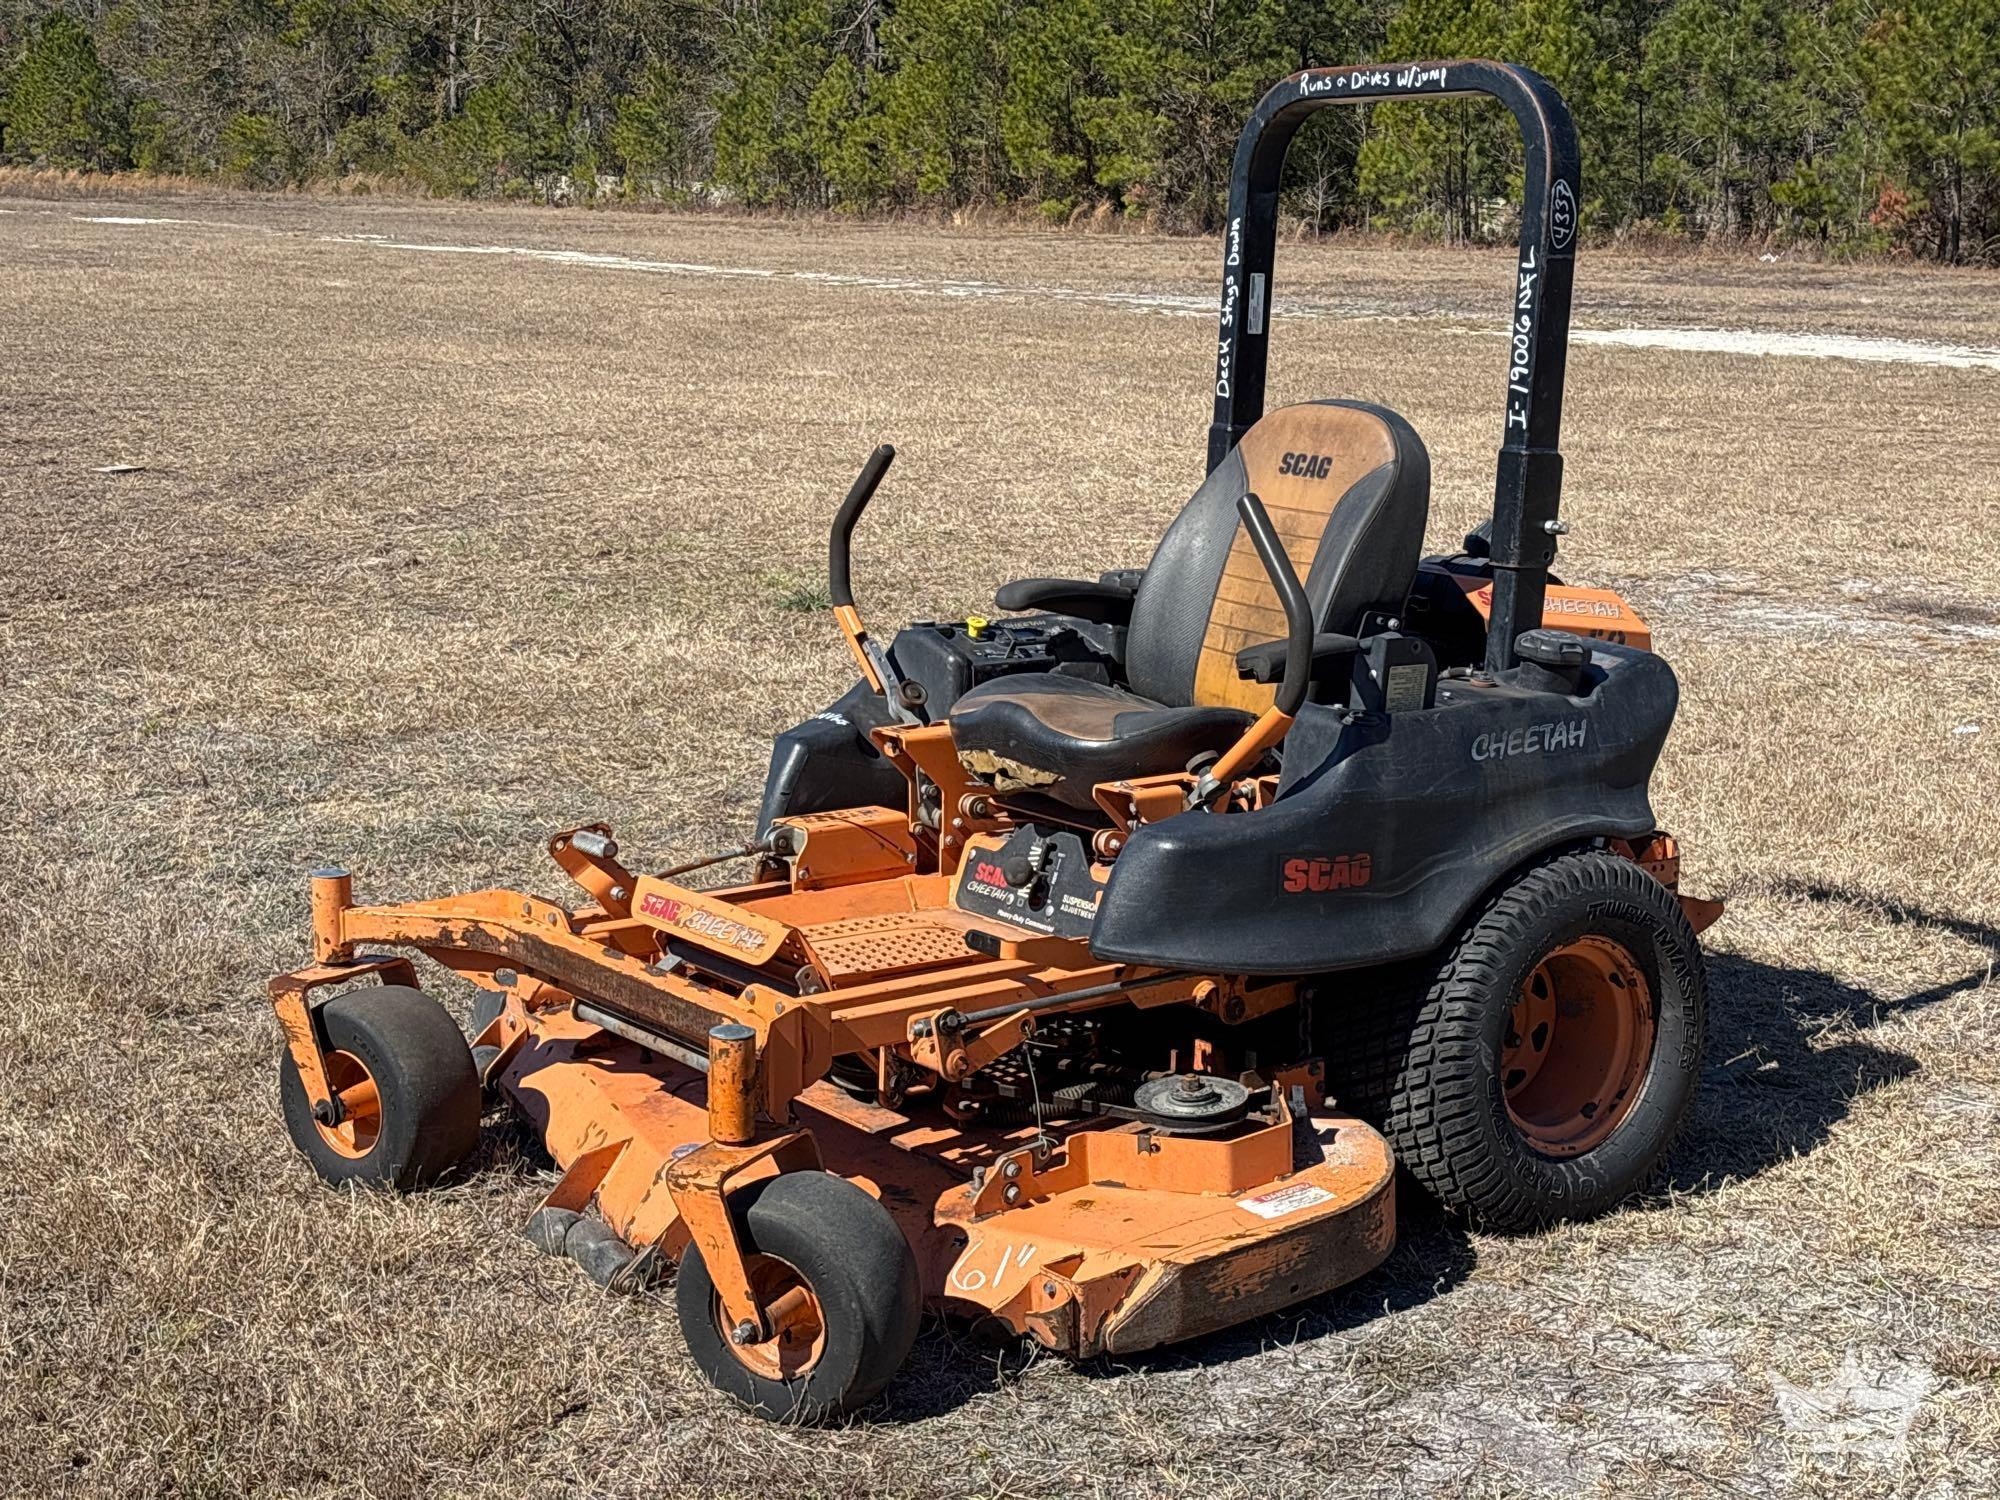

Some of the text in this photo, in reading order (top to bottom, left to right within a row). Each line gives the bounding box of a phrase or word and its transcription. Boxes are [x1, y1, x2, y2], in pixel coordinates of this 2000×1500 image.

[1300, 72, 1332, 96] Runs
[1351, 71, 1390, 90] Drives
[1553, 181, 1571, 240] 4337
[1227, 217, 1241, 266] Down
[1221, 275, 1239, 328] Stays
[1278, 451, 1333, 480] SCAG
[1471, 719, 1587, 761] CHEETAH
[967, 880, 1009, 902] CHEETAH
[1283, 853, 1371, 893] SCAG
[640, 892, 683, 922] SCAG
[1060, 903, 1096, 921] ADJUSTMENT
[1585, 898, 1699, 1073] TURF MASTER
[951, 1239, 1037, 1291] 61"
